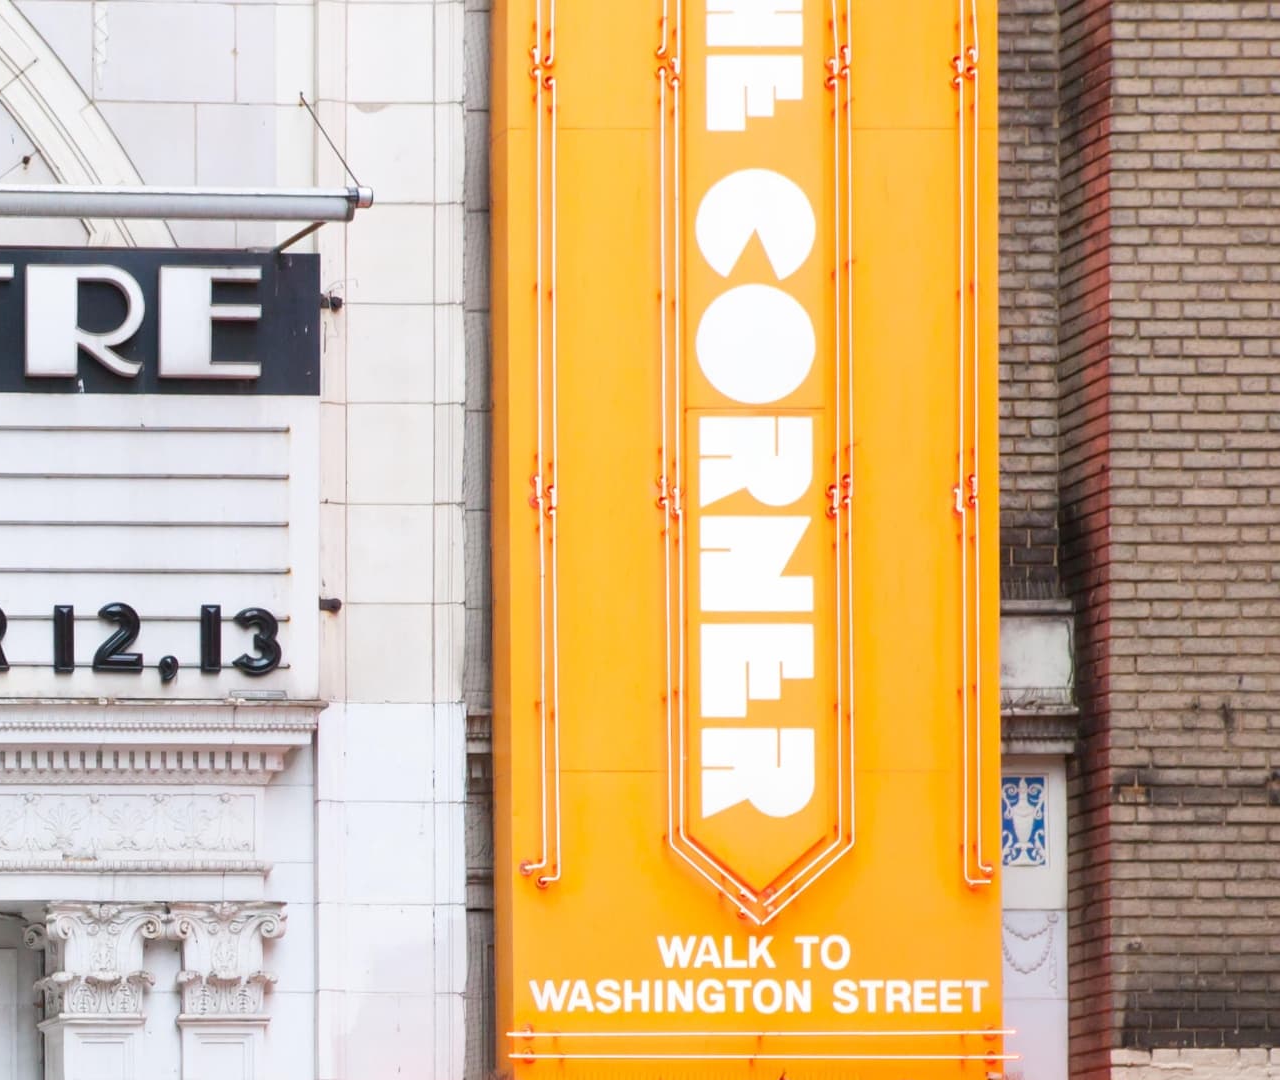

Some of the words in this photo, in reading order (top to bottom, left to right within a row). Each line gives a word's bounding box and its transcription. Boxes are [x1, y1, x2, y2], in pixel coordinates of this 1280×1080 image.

[695, 167, 817, 819] CORNER
[53, 601, 283, 684] 12,13
[657, 935, 775, 969] WALK
[795, 934, 852, 970] TO
[529, 979, 812, 1014] WASHINGTON
[832, 978, 989, 1014] STREET
